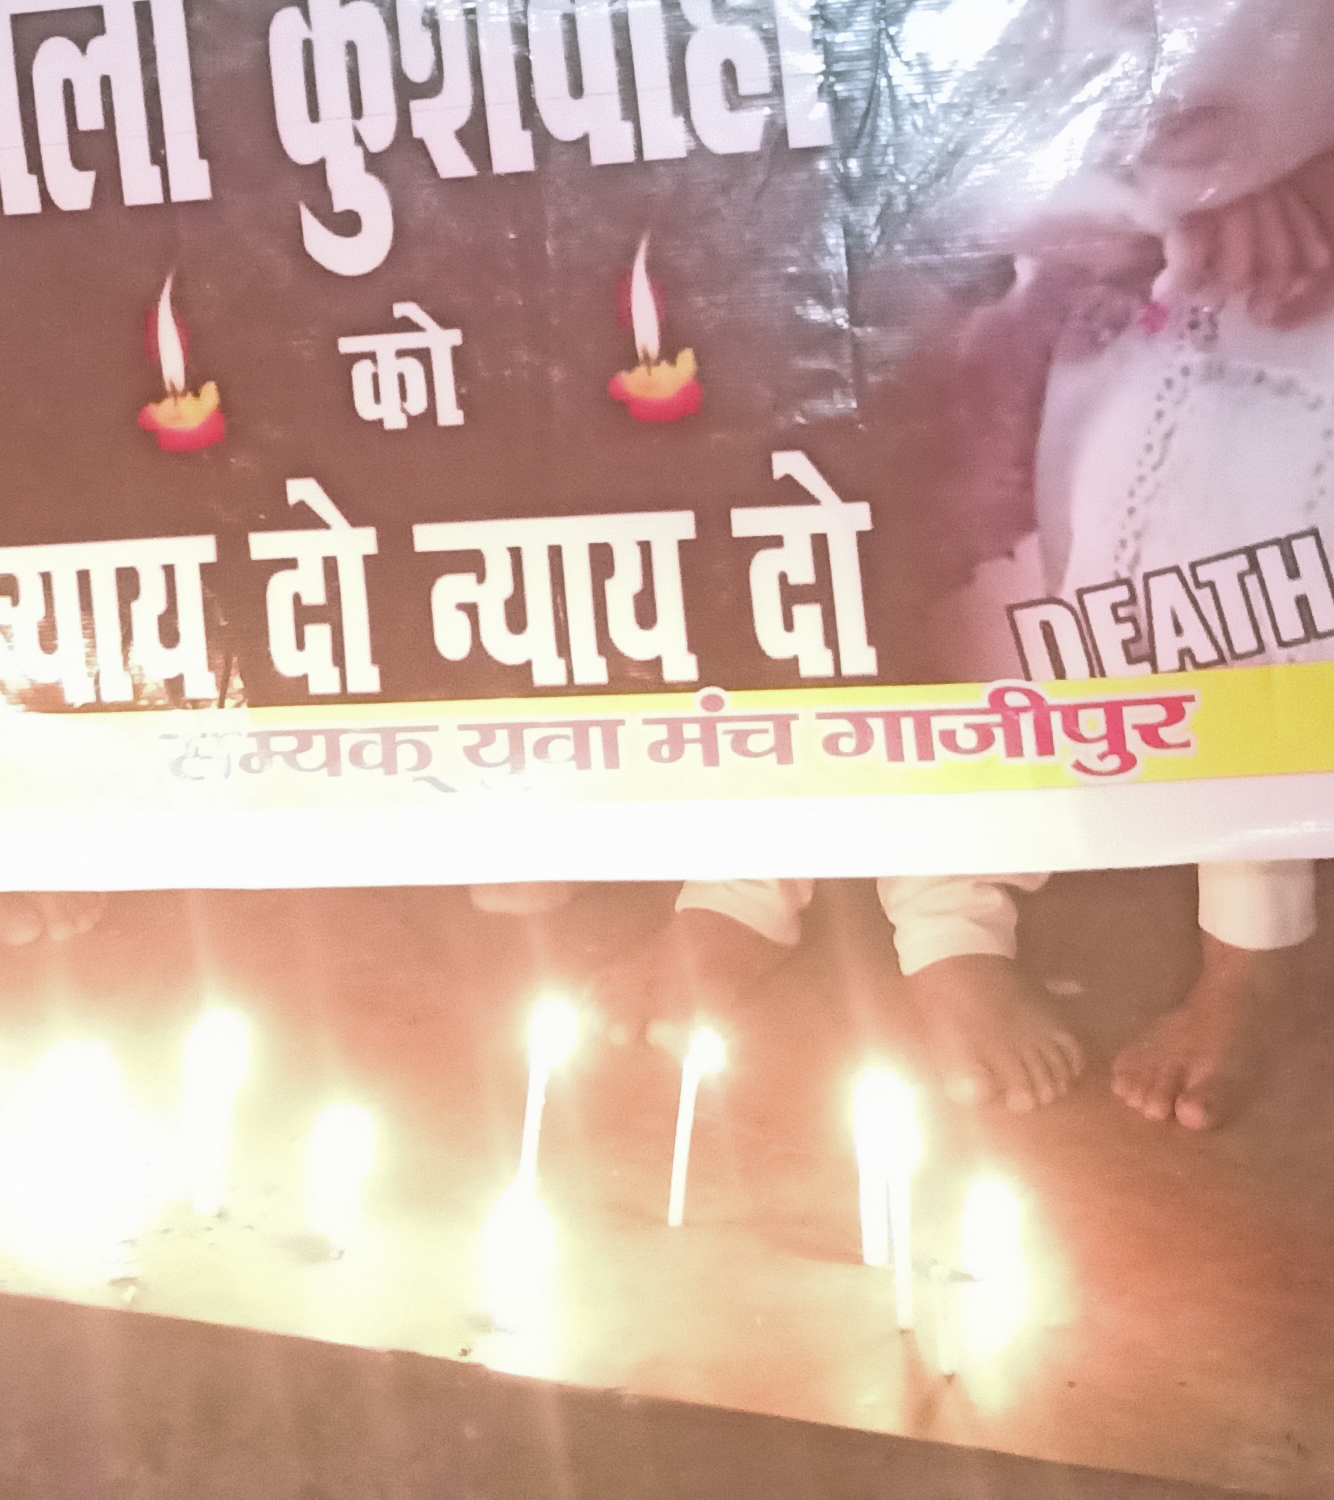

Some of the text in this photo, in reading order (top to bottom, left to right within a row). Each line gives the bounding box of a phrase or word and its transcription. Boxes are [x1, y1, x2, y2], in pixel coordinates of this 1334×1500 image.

[338, 302, 464, 430] को
[248, 477, 381, 694] दो
[412, 509, 698, 686] न्याय
[730, 450, 878, 679] दो
[457, 719, 627, 790] यवा
[642, 689, 800, 767] मंच
[816, 688, 1197, 777] गाजीपुर
